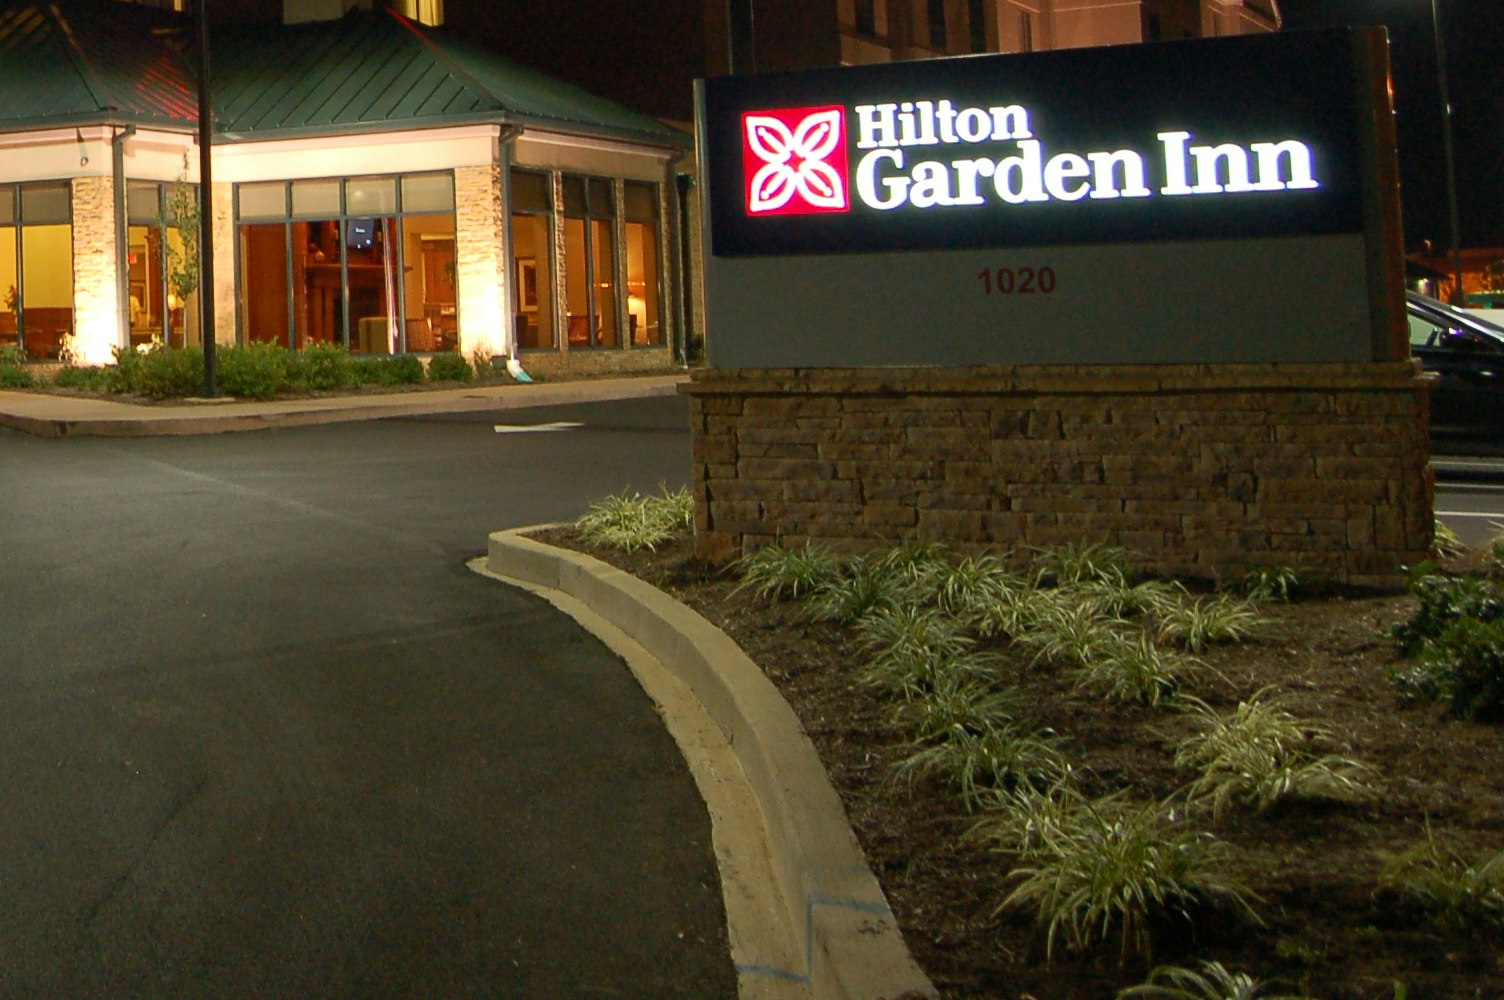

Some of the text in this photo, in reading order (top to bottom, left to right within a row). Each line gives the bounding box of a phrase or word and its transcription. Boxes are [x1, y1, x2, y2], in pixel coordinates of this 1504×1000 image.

[854, 99, 1034, 149] Hilton
[855, 130, 1320, 211] Garden Inn
[977, 265, 1056, 295] 1020
